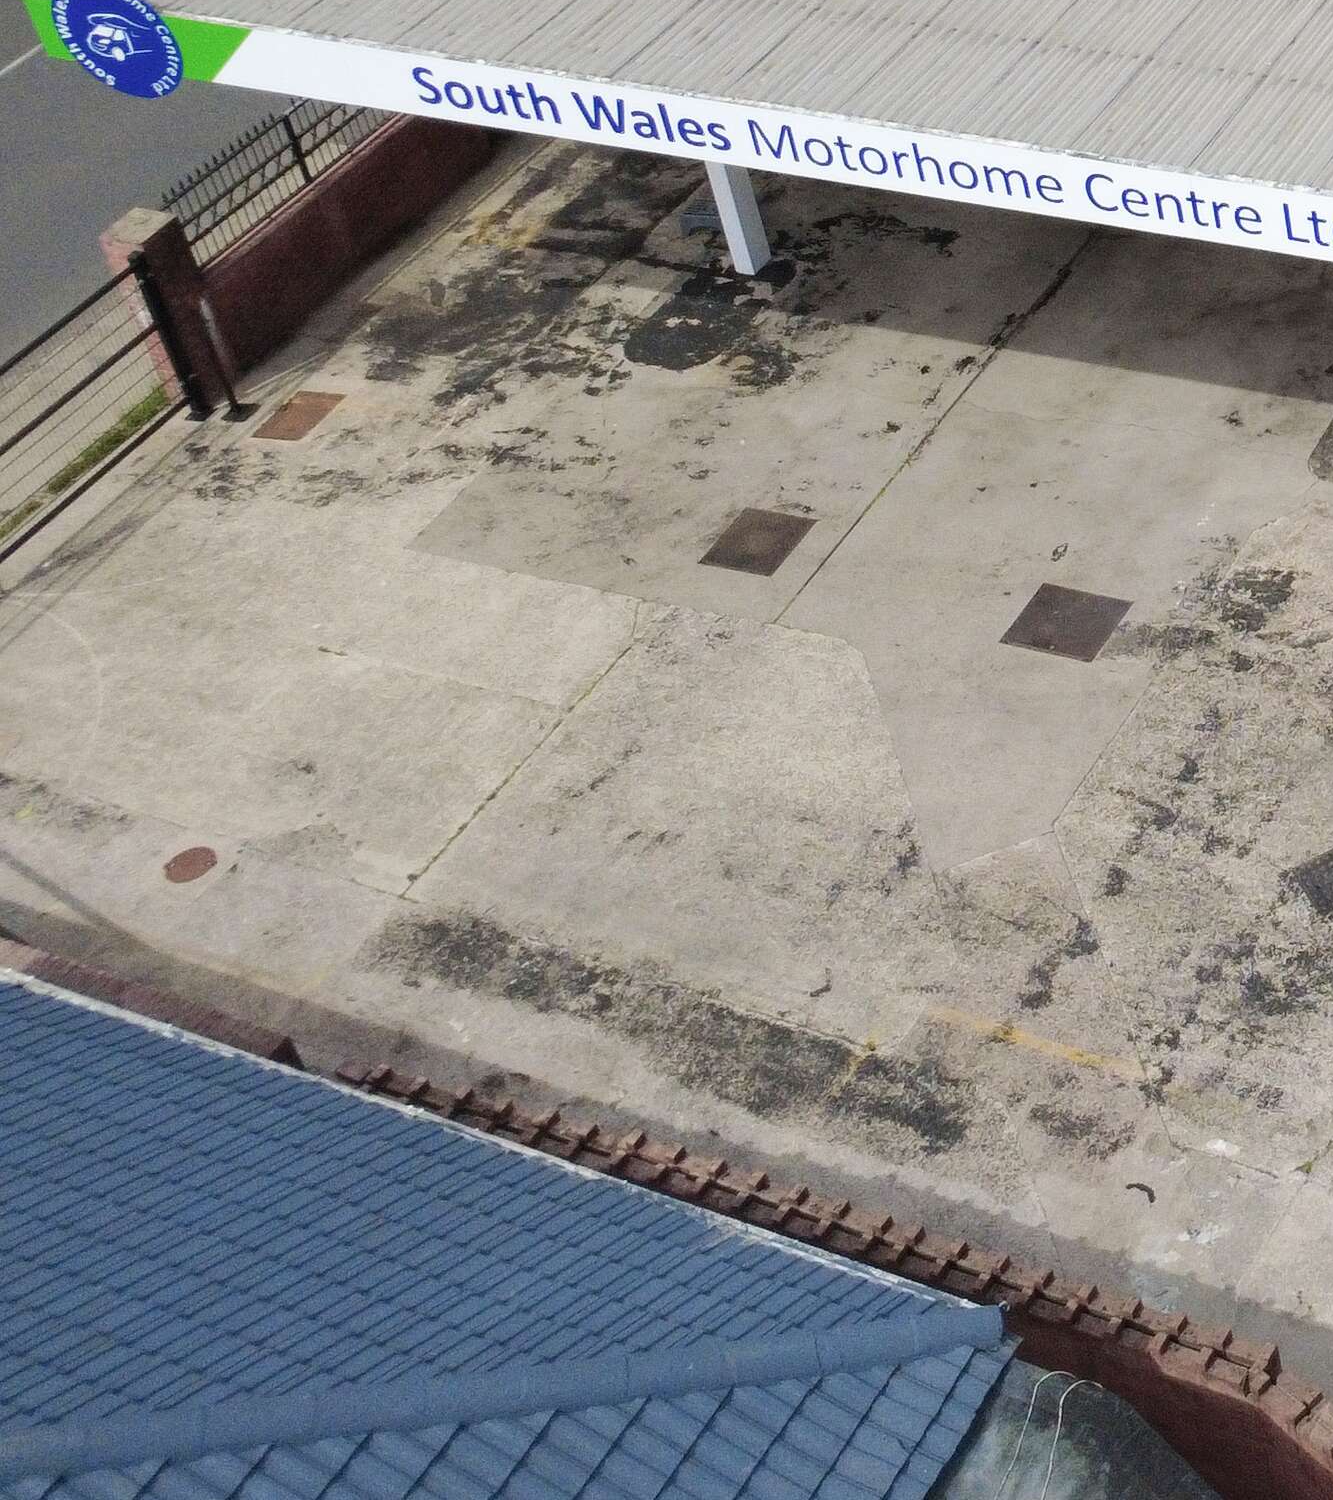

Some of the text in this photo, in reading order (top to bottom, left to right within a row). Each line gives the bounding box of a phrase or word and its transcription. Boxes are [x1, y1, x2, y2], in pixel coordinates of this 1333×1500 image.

[68, 42, 116, 86] South
[156, 24, 180, 78] Centre
[151, 75, 177, 96] Ltd
[410, 66, 562, 125] South
[570, 90, 733, 152] Wales
[747, 118, 1065, 205] Motorhome
[1083, 172, 1264, 236] Centre
